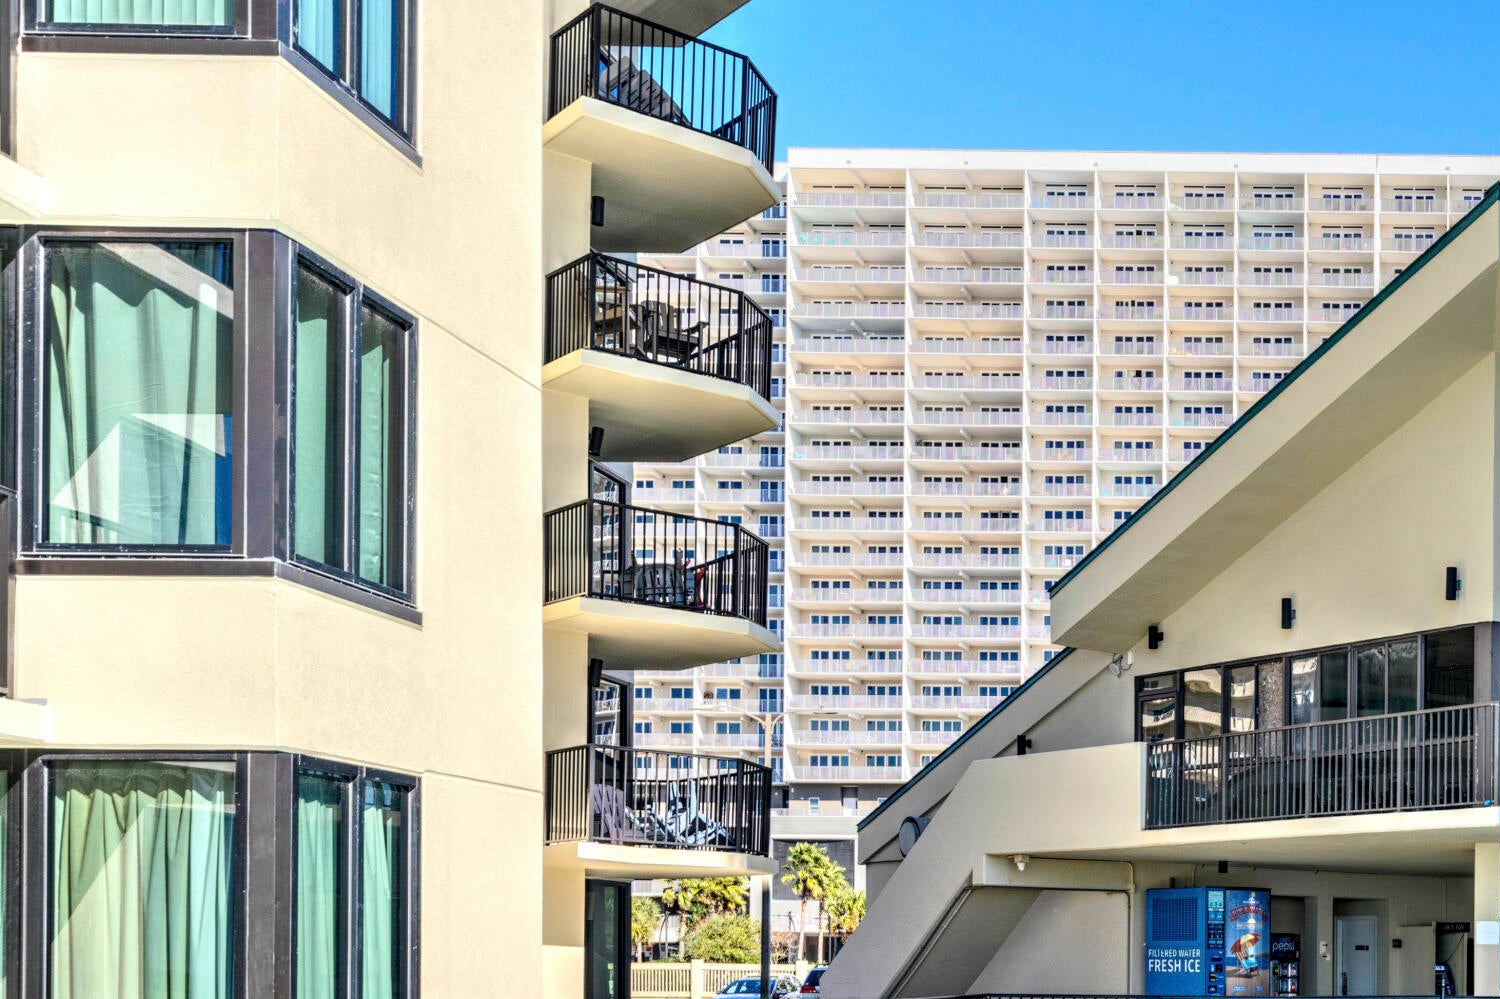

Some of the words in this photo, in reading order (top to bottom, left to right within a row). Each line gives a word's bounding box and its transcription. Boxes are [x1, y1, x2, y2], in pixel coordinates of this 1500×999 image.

[1148, 948, 1177, 957] FILTERED
[1178, 948, 1201, 957] WATER
[1272, 941, 1295, 953] pepsi
[1148, 959, 1182, 972] FRESH
[1184, 959, 1201, 973] ICE
